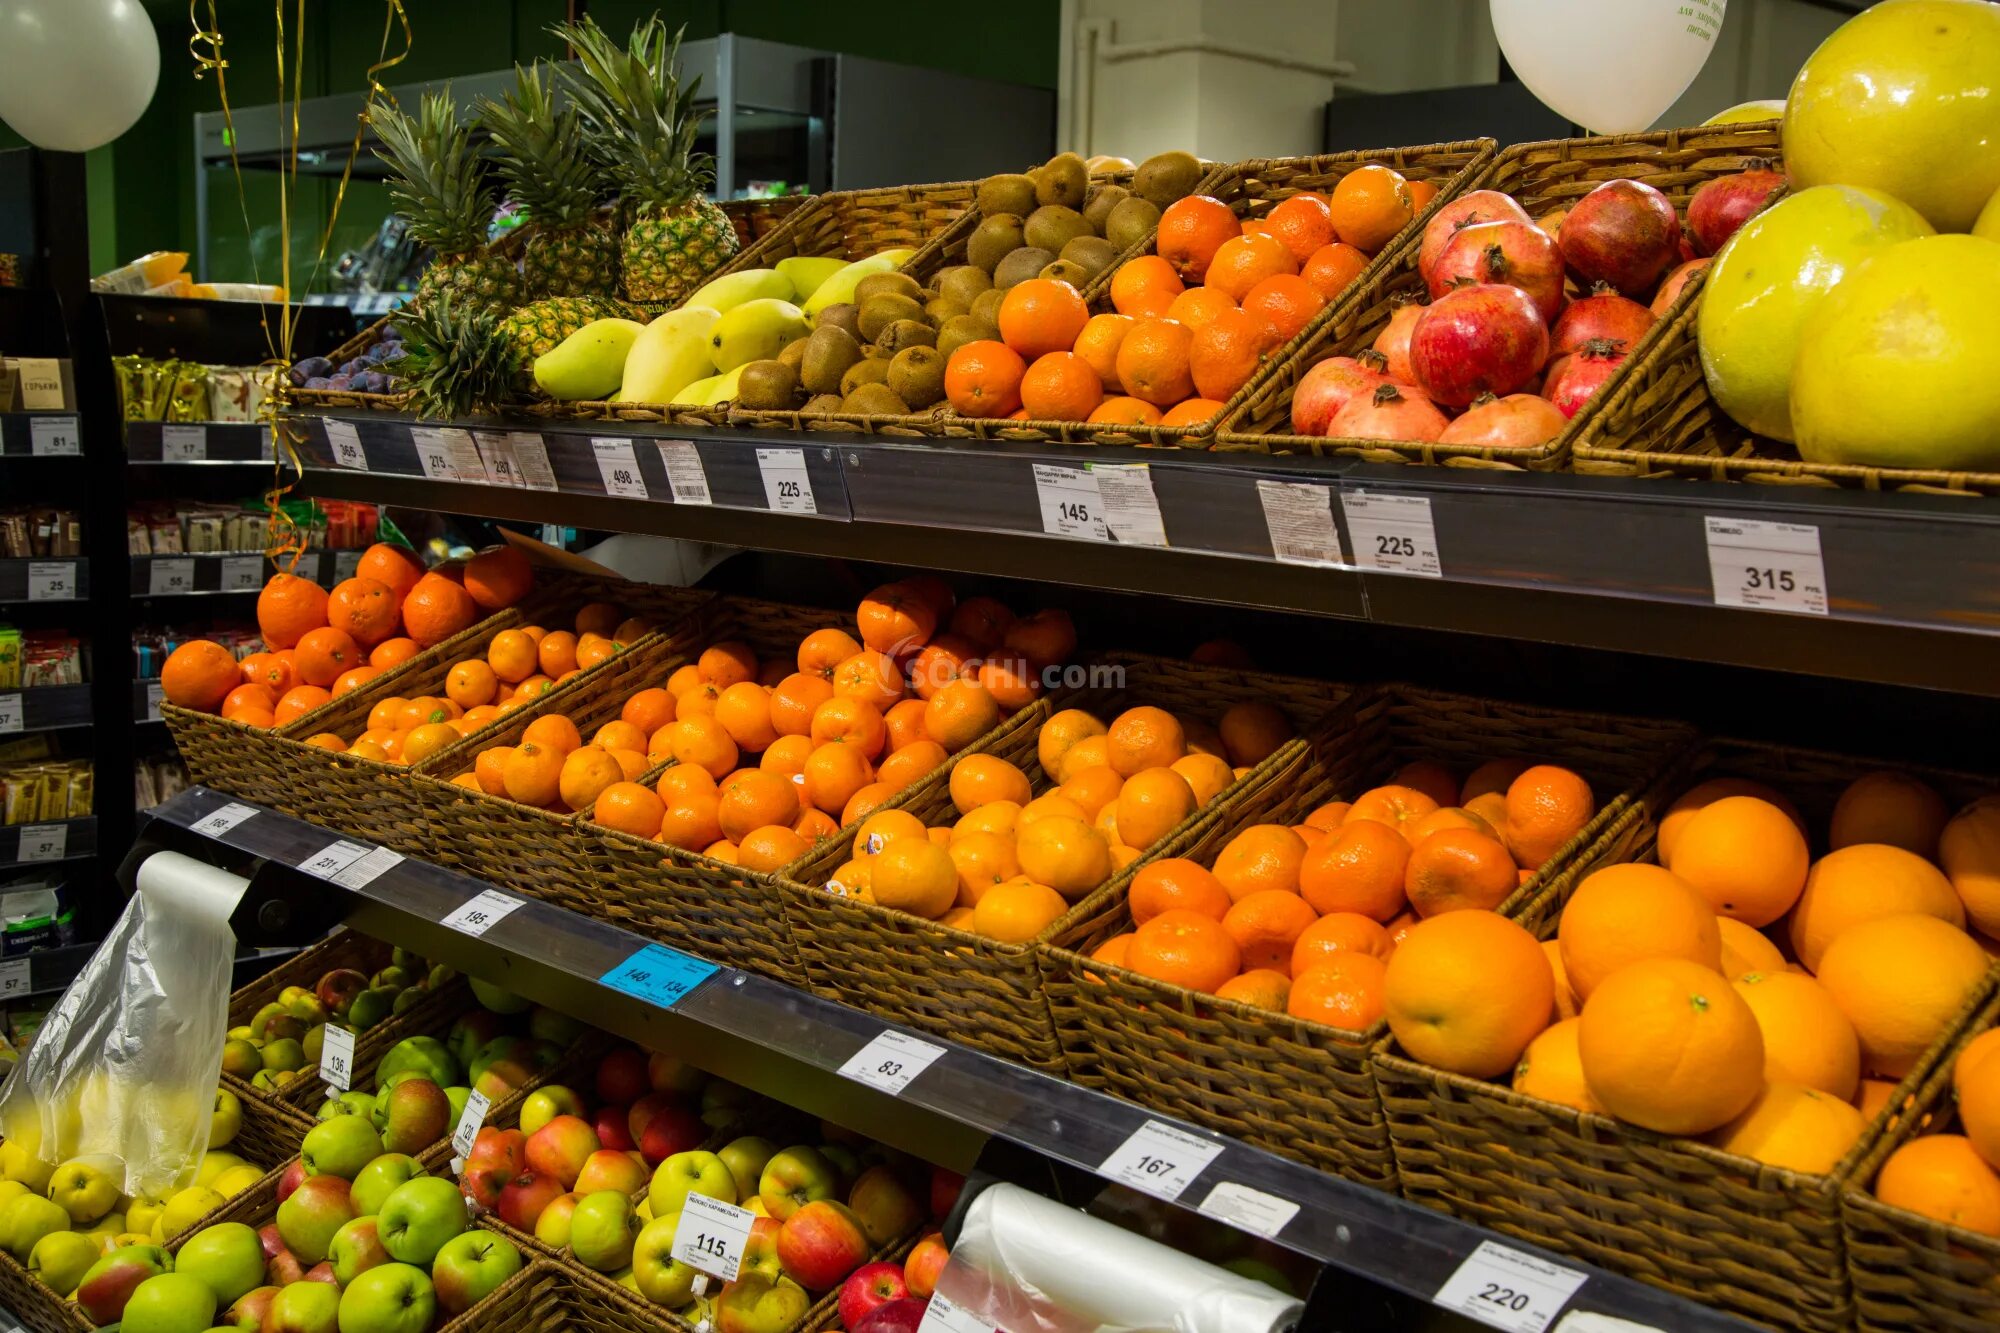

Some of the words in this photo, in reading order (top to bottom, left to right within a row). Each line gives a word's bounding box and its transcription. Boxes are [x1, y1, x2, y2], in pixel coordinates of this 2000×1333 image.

[24, 381, 58, 391] ГОРЬКИЙ
[53, 436, 66, 447] 81
[183, 444, 195, 454] 17
[339, 443, 357, 458] 365
[429, 455, 446, 469] 275
[493, 460, 511, 475] 287
[613, 469, 632, 485] 498
[778, 481, 800, 498] 225
[1059, 502, 1088, 522] 145
[1709, 526, 1743, 536] ПОМЕЛО
[1376, 535, 1415, 557] 225
[49, 580, 64, 591] 25
[1745, 567, 1795, 592] 315
[40, 843, 54, 853] 57
[315, 857, 338, 871] 231
[463, 910, 489, 925] 195
[624, 968, 651, 982] 148
[5, 978, 18, 990] 57
[662, 981, 688, 994] 134
[331, 1055, 344, 1073] 136
[878, 1060, 902, 1076] 83
[1136, 1155, 1177, 1178] 167
[708, 1203, 739, 1219] КАРАМЕЛЬКА
[697, 1233, 727, 1257] 115
[1477, 1283, 1530, 1312] 220
